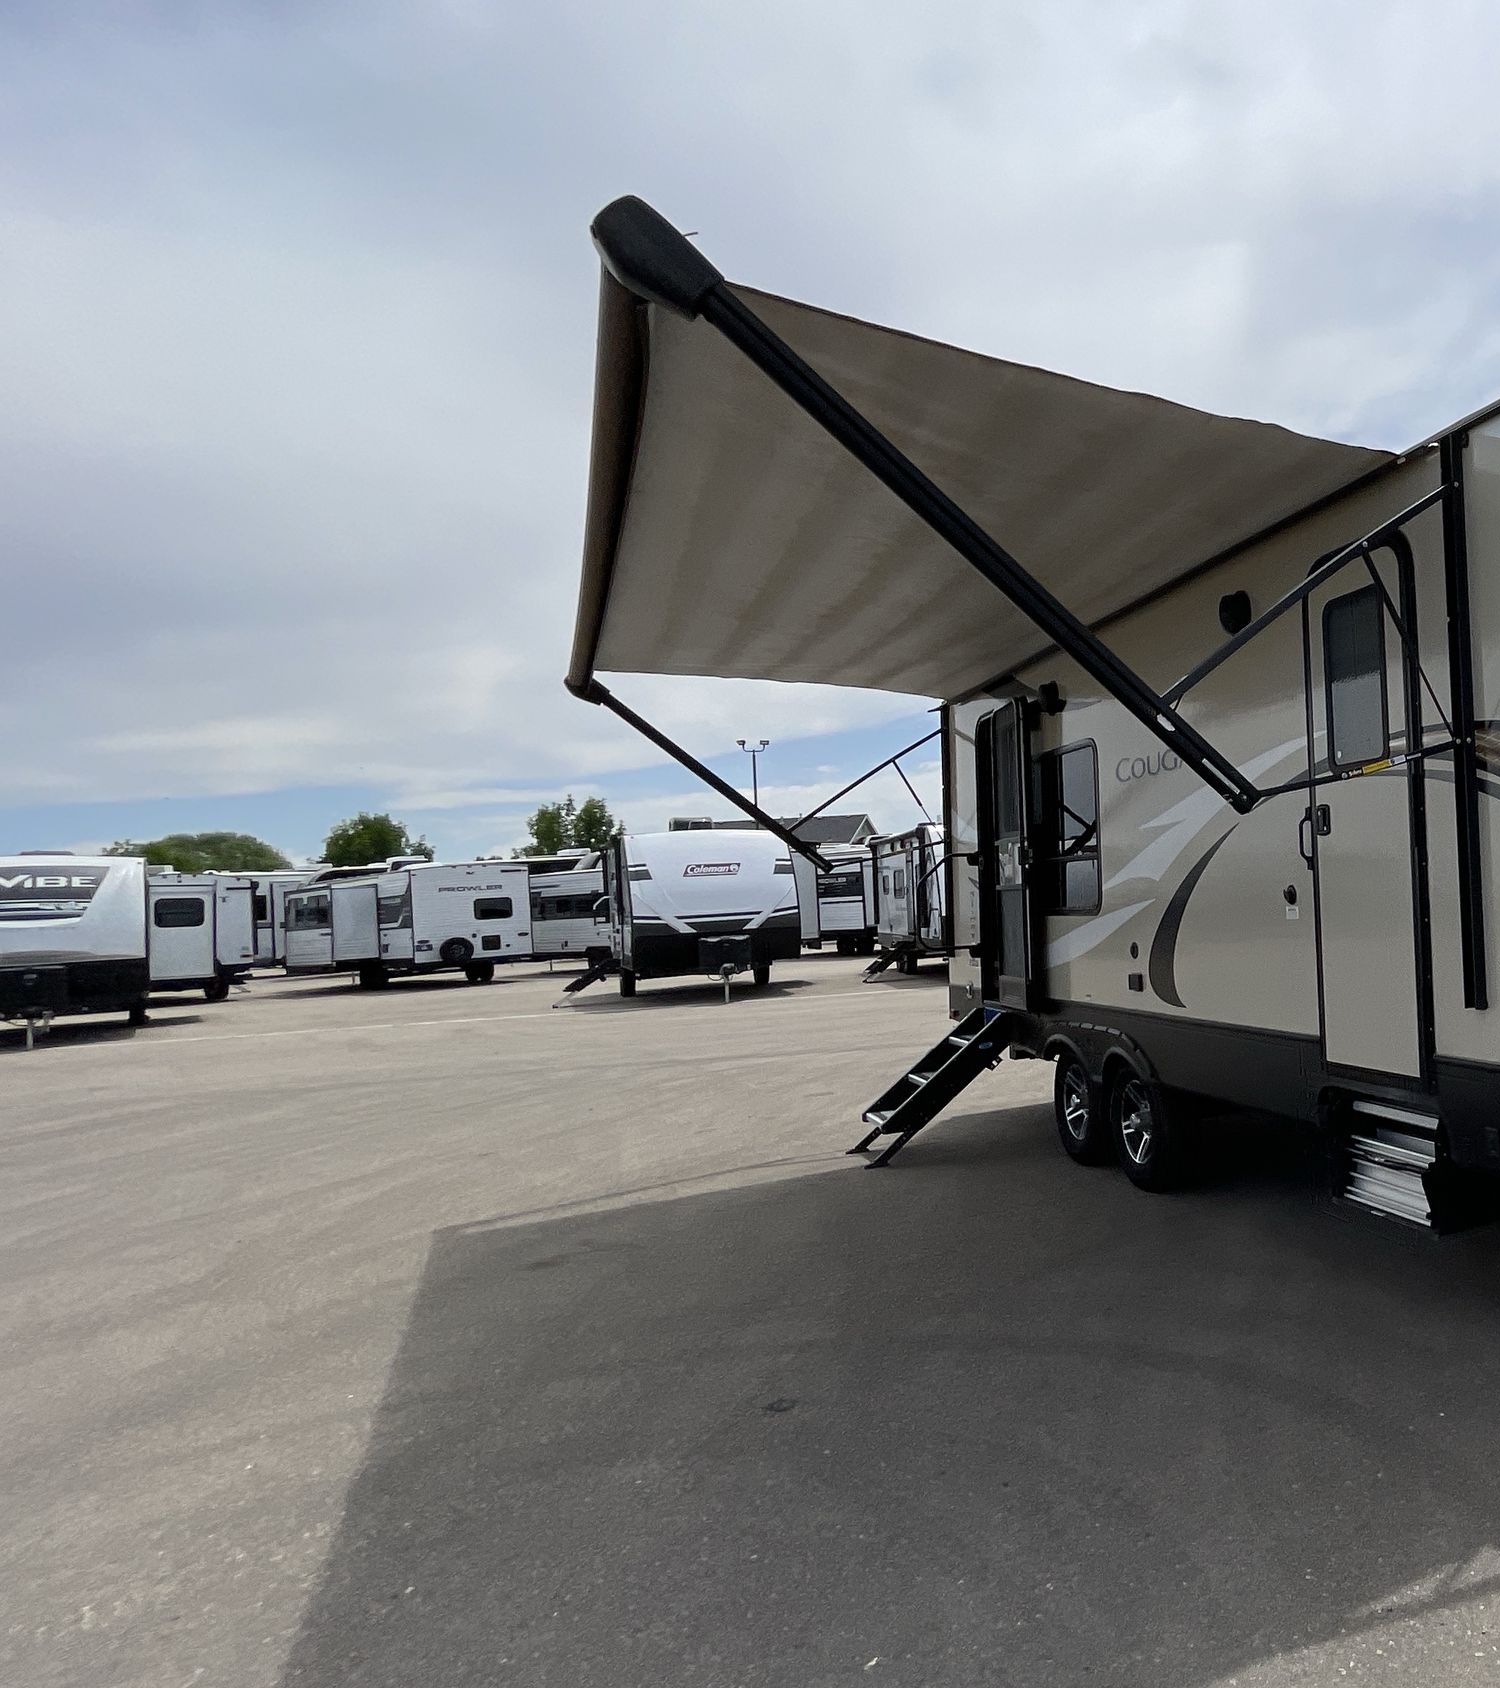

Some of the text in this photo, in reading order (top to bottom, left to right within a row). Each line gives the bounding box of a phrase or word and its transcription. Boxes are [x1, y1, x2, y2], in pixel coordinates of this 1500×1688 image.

[1115, 749, 1183, 782] COUG
[687, 864, 729, 874] Coleman
[438, 884, 503, 893] PROWLER
